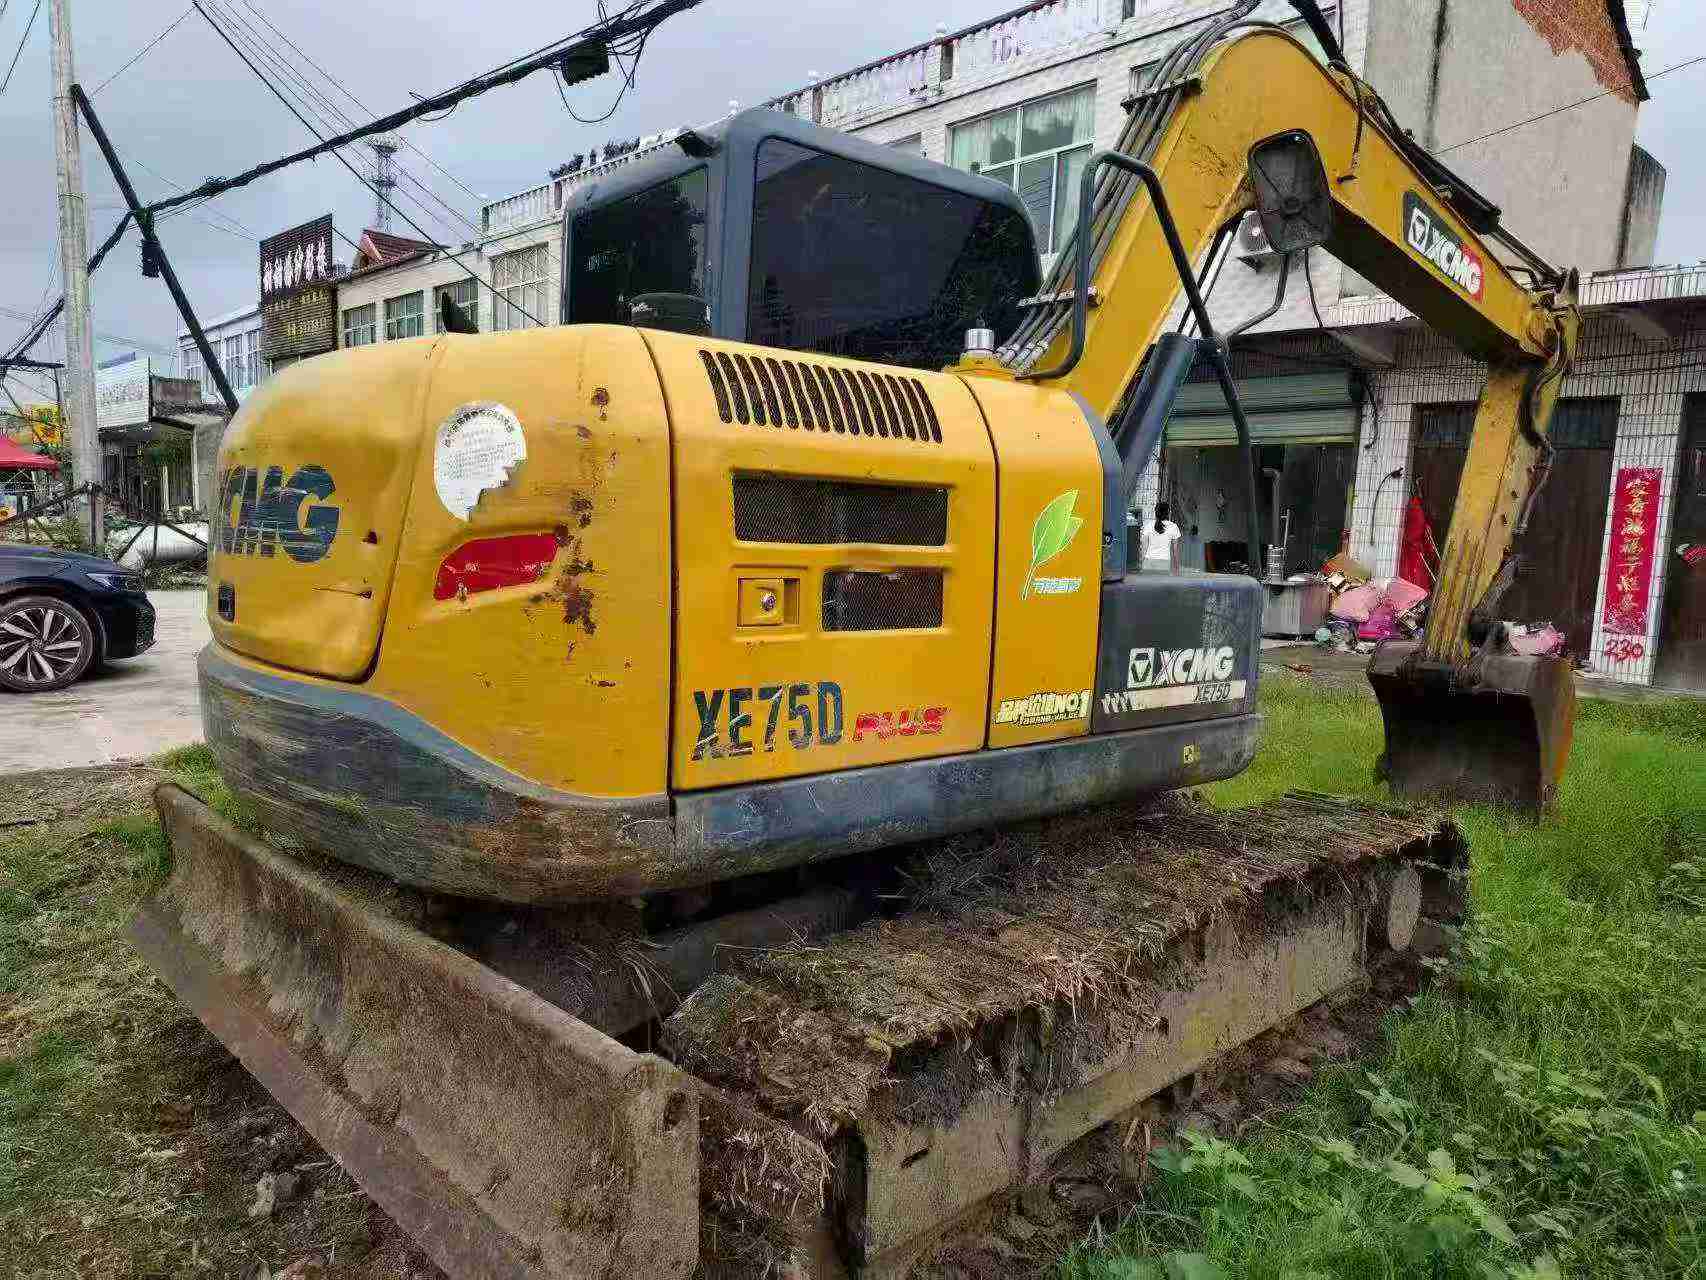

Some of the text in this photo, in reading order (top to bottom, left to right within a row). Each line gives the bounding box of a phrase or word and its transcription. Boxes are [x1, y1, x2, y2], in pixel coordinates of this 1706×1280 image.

[1424, 226, 1481, 294] XCMG
[1153, 646, 1234, 685] XCMG
[692, 681, 950, 760] XE75D PLUS
